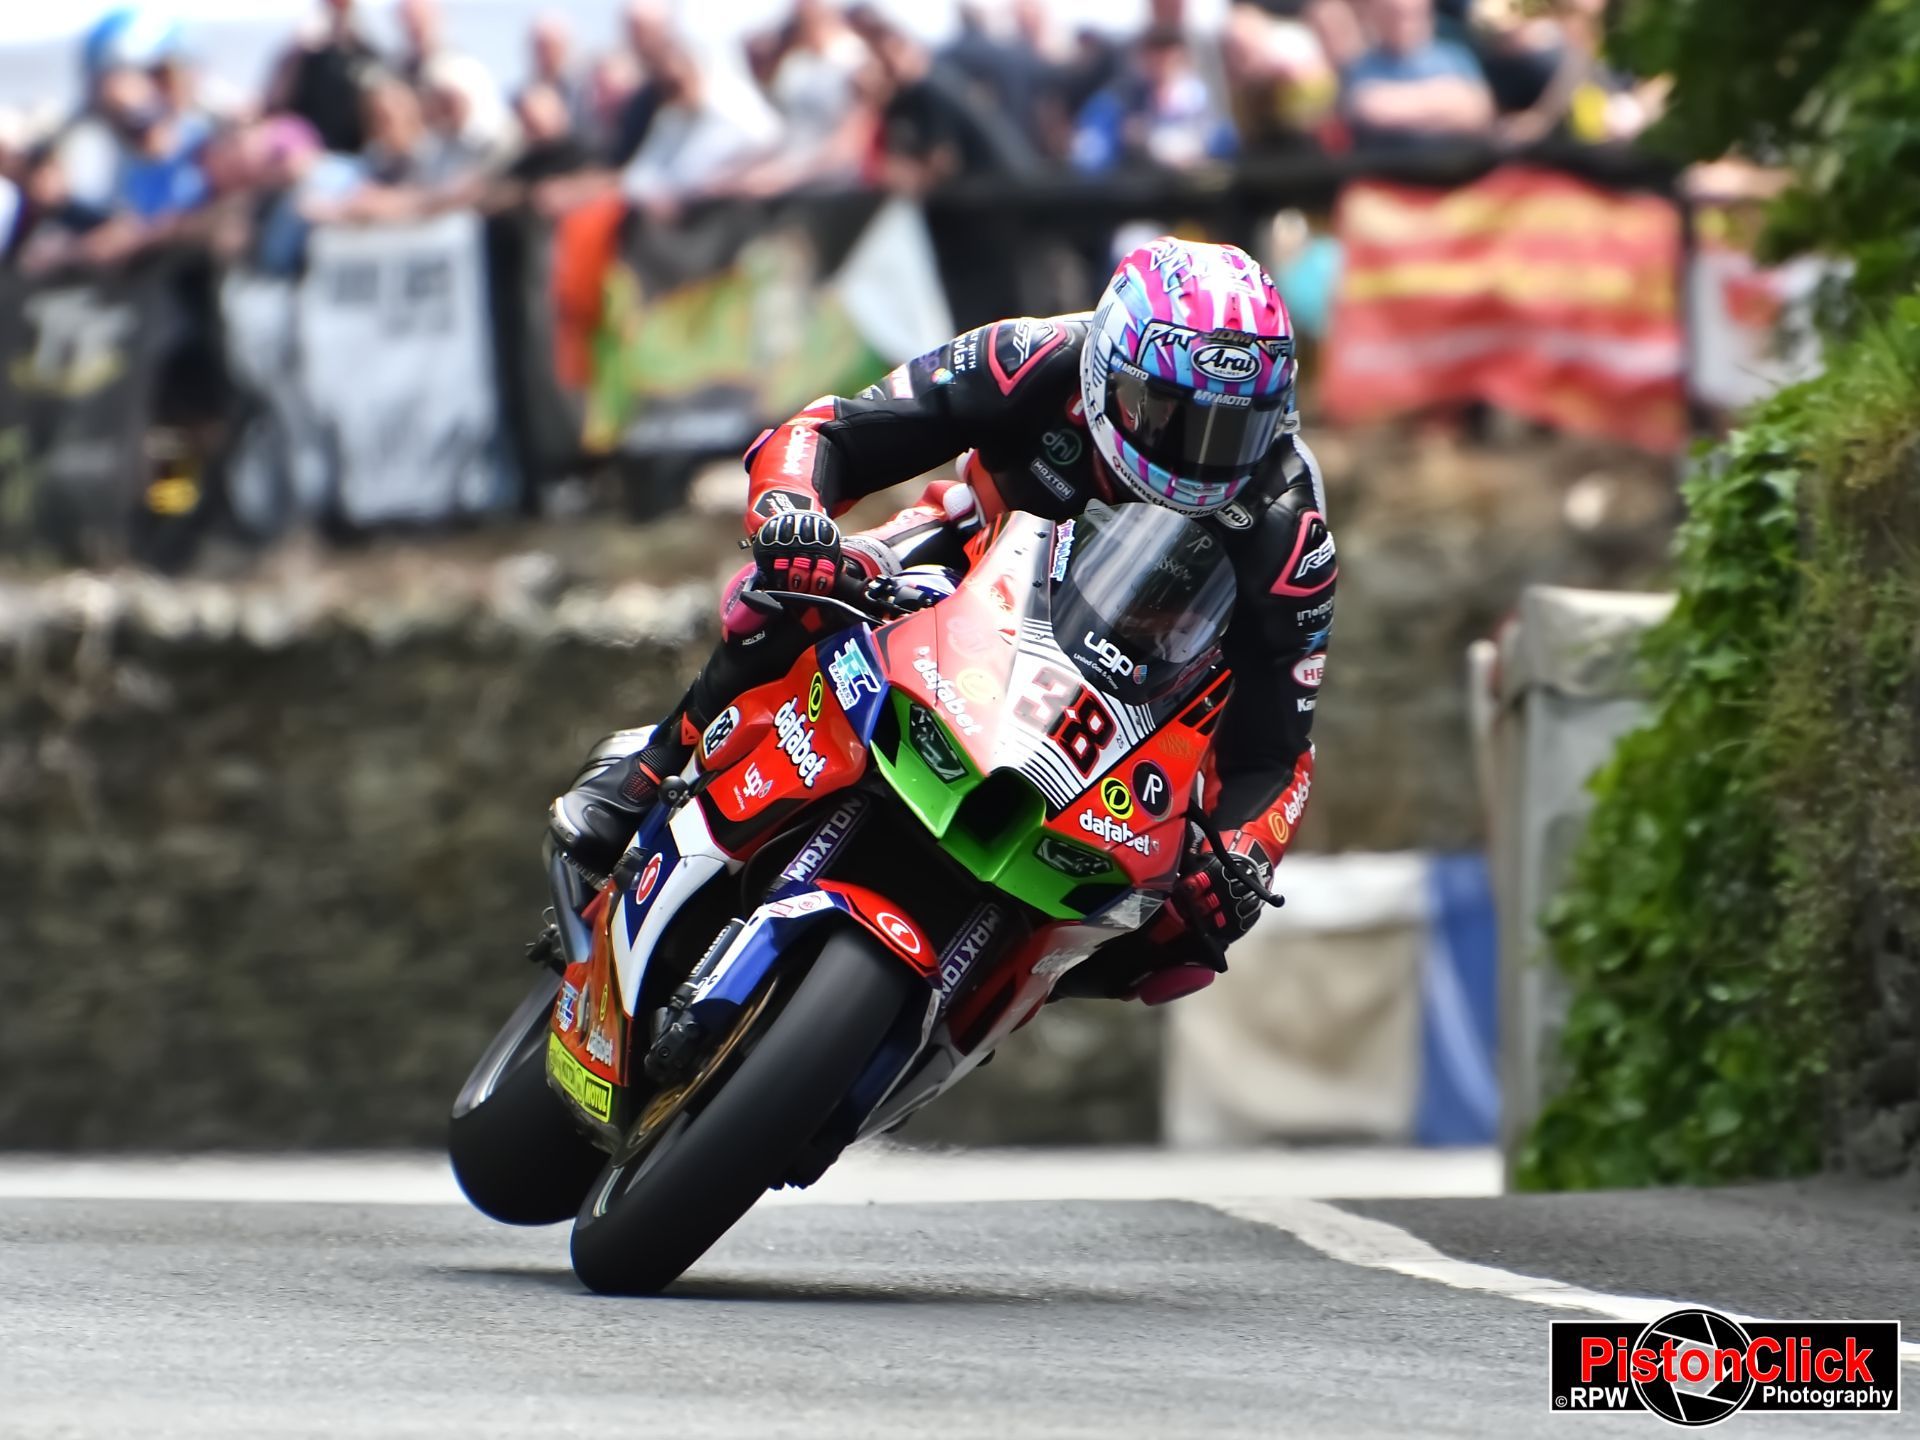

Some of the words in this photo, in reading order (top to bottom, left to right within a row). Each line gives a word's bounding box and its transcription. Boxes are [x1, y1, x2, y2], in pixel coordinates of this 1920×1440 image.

[953, 338, 969, 374] vlar.
[967, 343, 977, 369] WITH
[1121, 363, 1150, 381] MOTO
[1198, 349, 1254, 373] Arai
[1213, 394, 1252, 407] MOTO
[1034, 461, 1072, 496] MAXTON
[1073, 652, 1093, 666] United
[1091, 662, 1103, 674] Gas
[1084, 631, 1134, 677] ugp
[831, 664, 855, 705] EXPRESS
[911, 657, 983, 738] dafabet
[1013, 666, 1118, 780] 38
[773, 696, 827, 789] dafabet
[788, 797, 864, 883] MAXTON
[1078, 808, 1150, 856] dafabet
[586, 1080, 608, 1113] MOTUL
